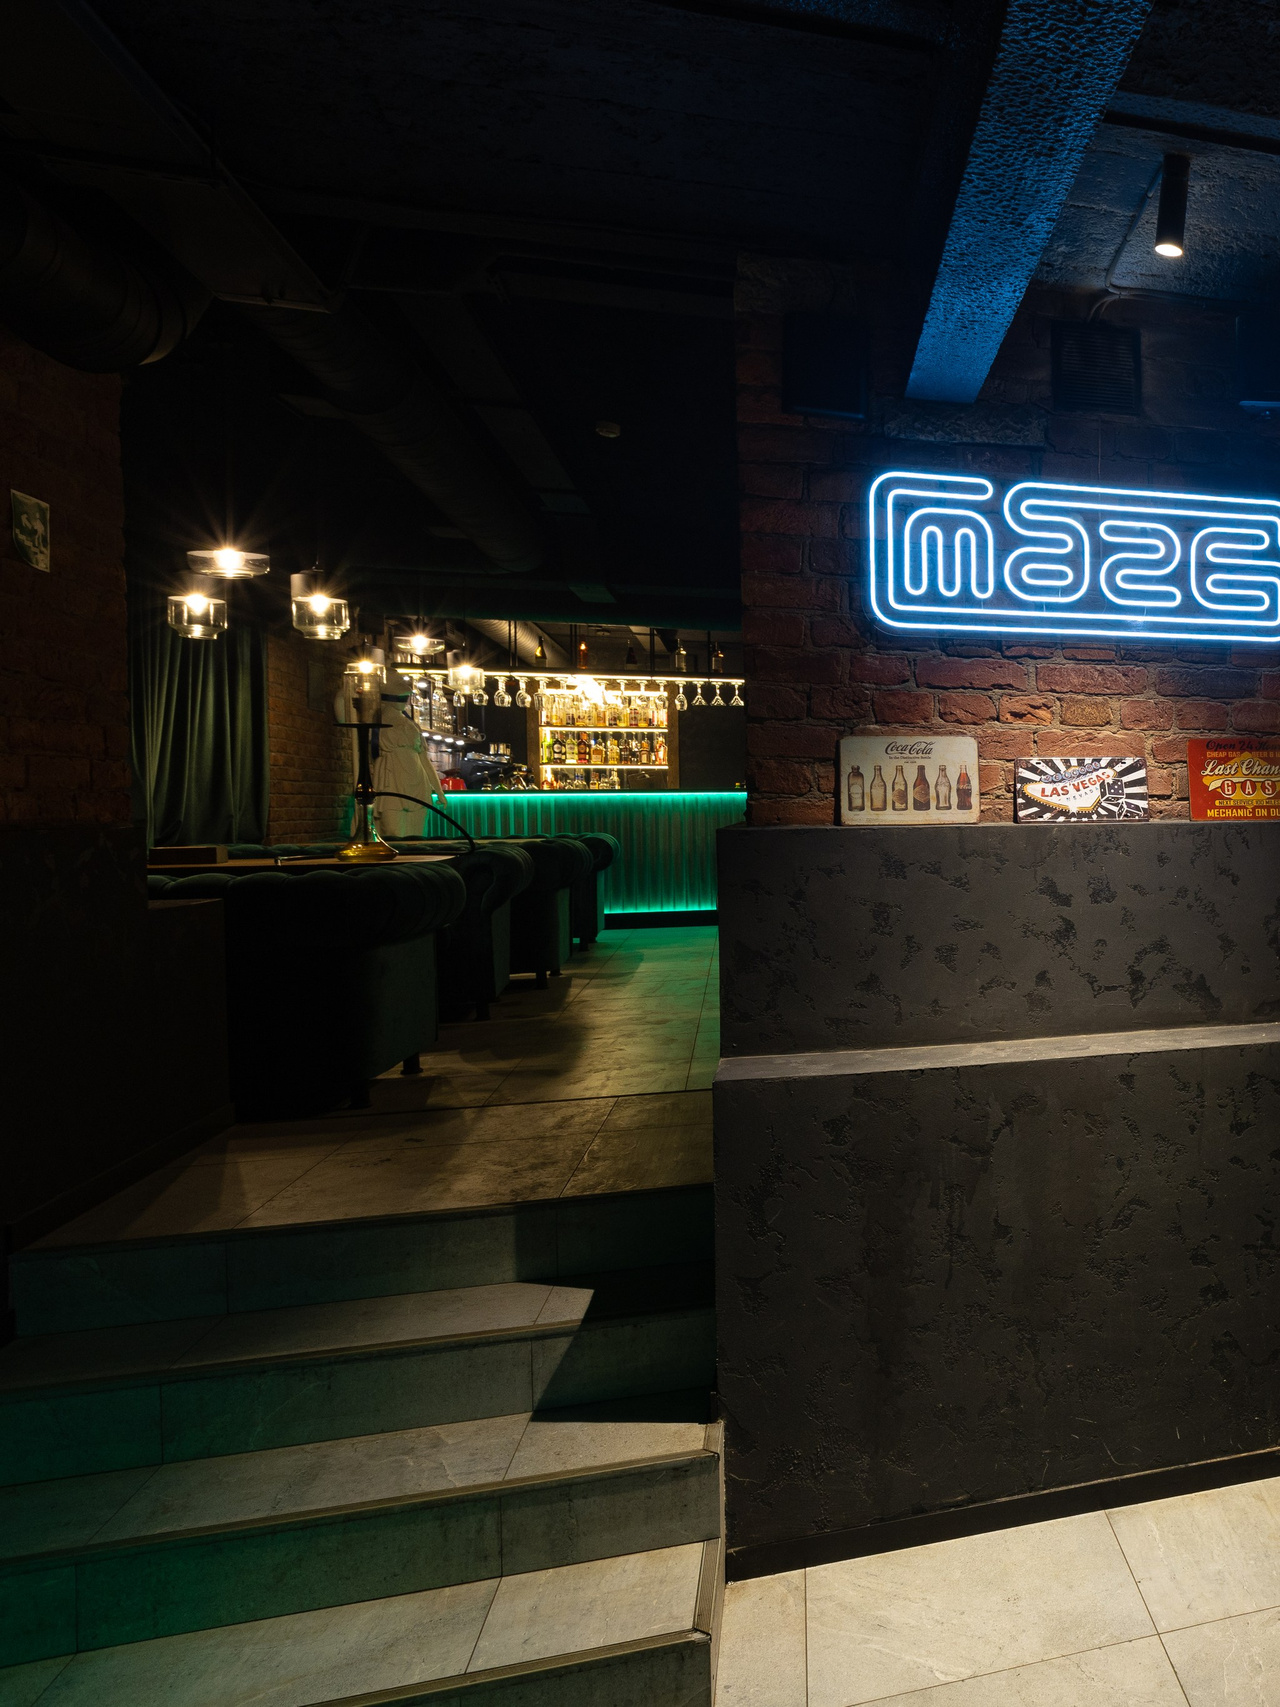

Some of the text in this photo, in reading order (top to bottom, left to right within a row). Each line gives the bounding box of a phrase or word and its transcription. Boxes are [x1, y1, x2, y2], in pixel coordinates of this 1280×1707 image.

[885, 740, 936, 755] Coca-Cola
[1206, 740, 1236, 752] Open
[1239, 740, 1253, 751] 24
[1201, 758, 1239, 776] Last
[1040, 785, 1070, 798] LAS
[1072, 771, 1111, 793] VEGAS
[1224, 780, 1272, 795] GAS
[1207, 808, 1253, 817] MECHANIC
[1255, 808, 1268, 817] ON
